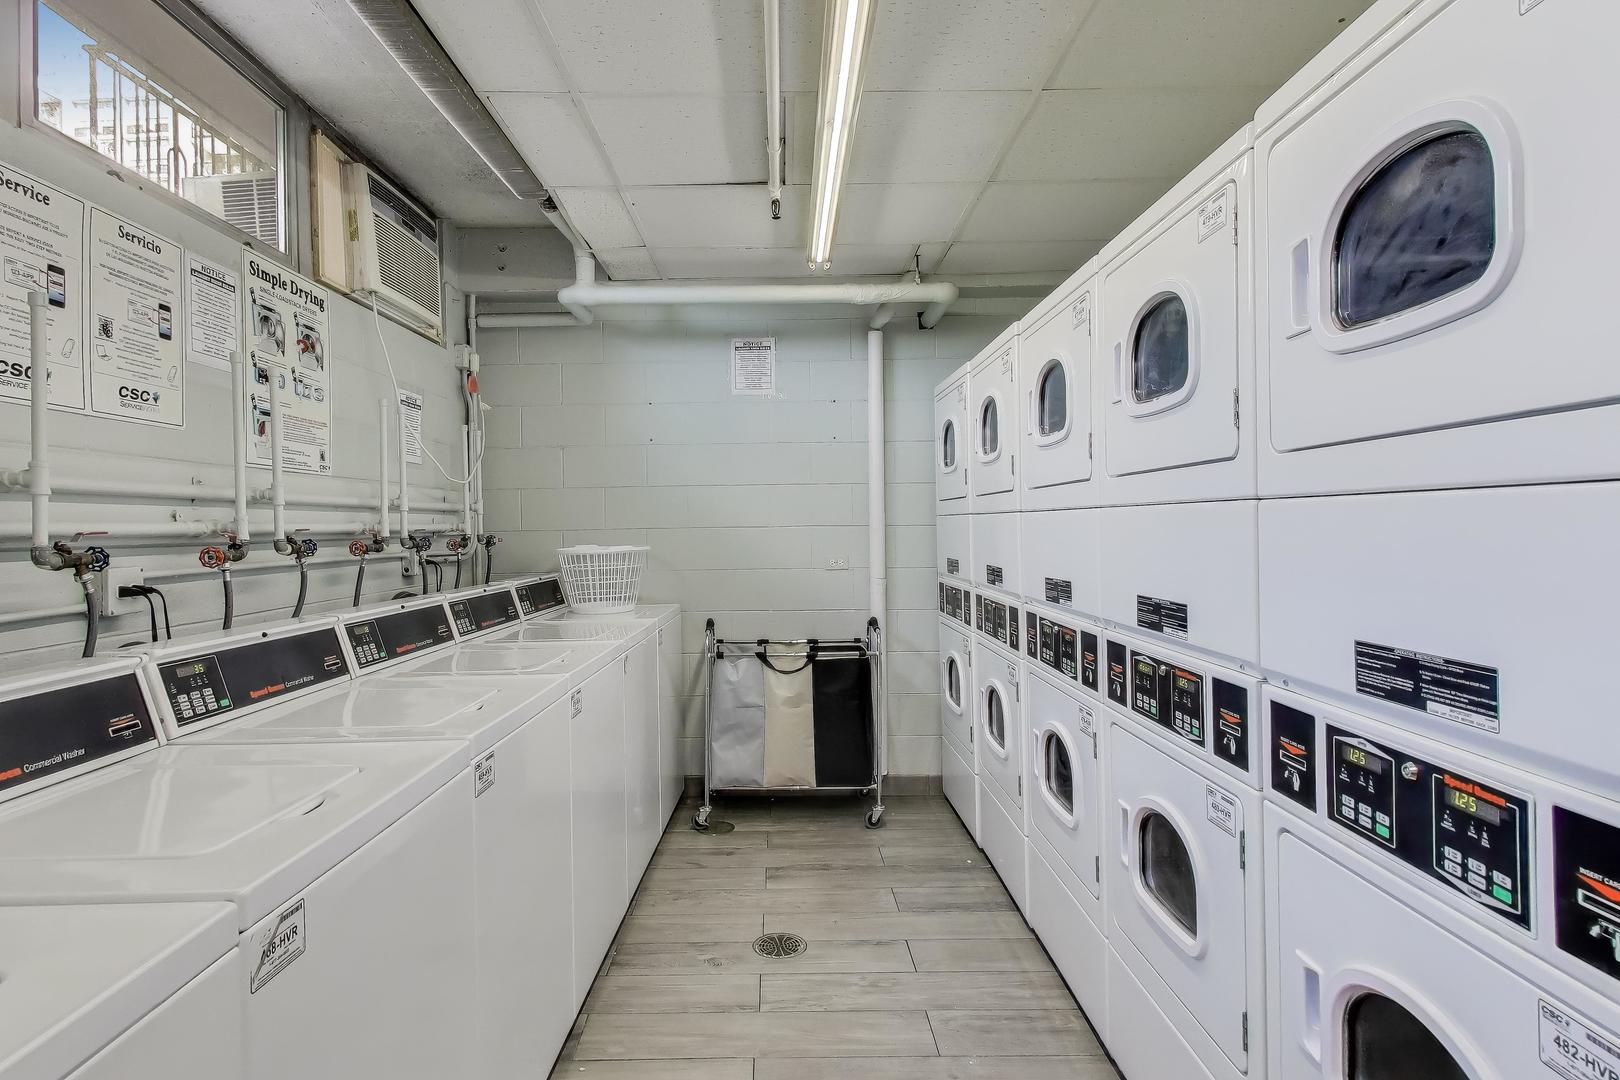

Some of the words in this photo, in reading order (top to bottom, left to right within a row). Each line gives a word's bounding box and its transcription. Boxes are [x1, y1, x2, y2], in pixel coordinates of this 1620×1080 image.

[0, 170, 50, 206] Service
[118, 224, 162, 255] Servicio
[201, 264, 227, 282] NOTICE
[249, 260, 288, 292] Simple
[290, 280, 325, 313] Drying
[119, 386, 151, 402] CSC
[193, 664, 204, 674] 35
[24, 754, 62, 773] Commercial
[62, 748, 86, 764] Washer
[1554, 1034, 1620, 1080] 482-HVR
